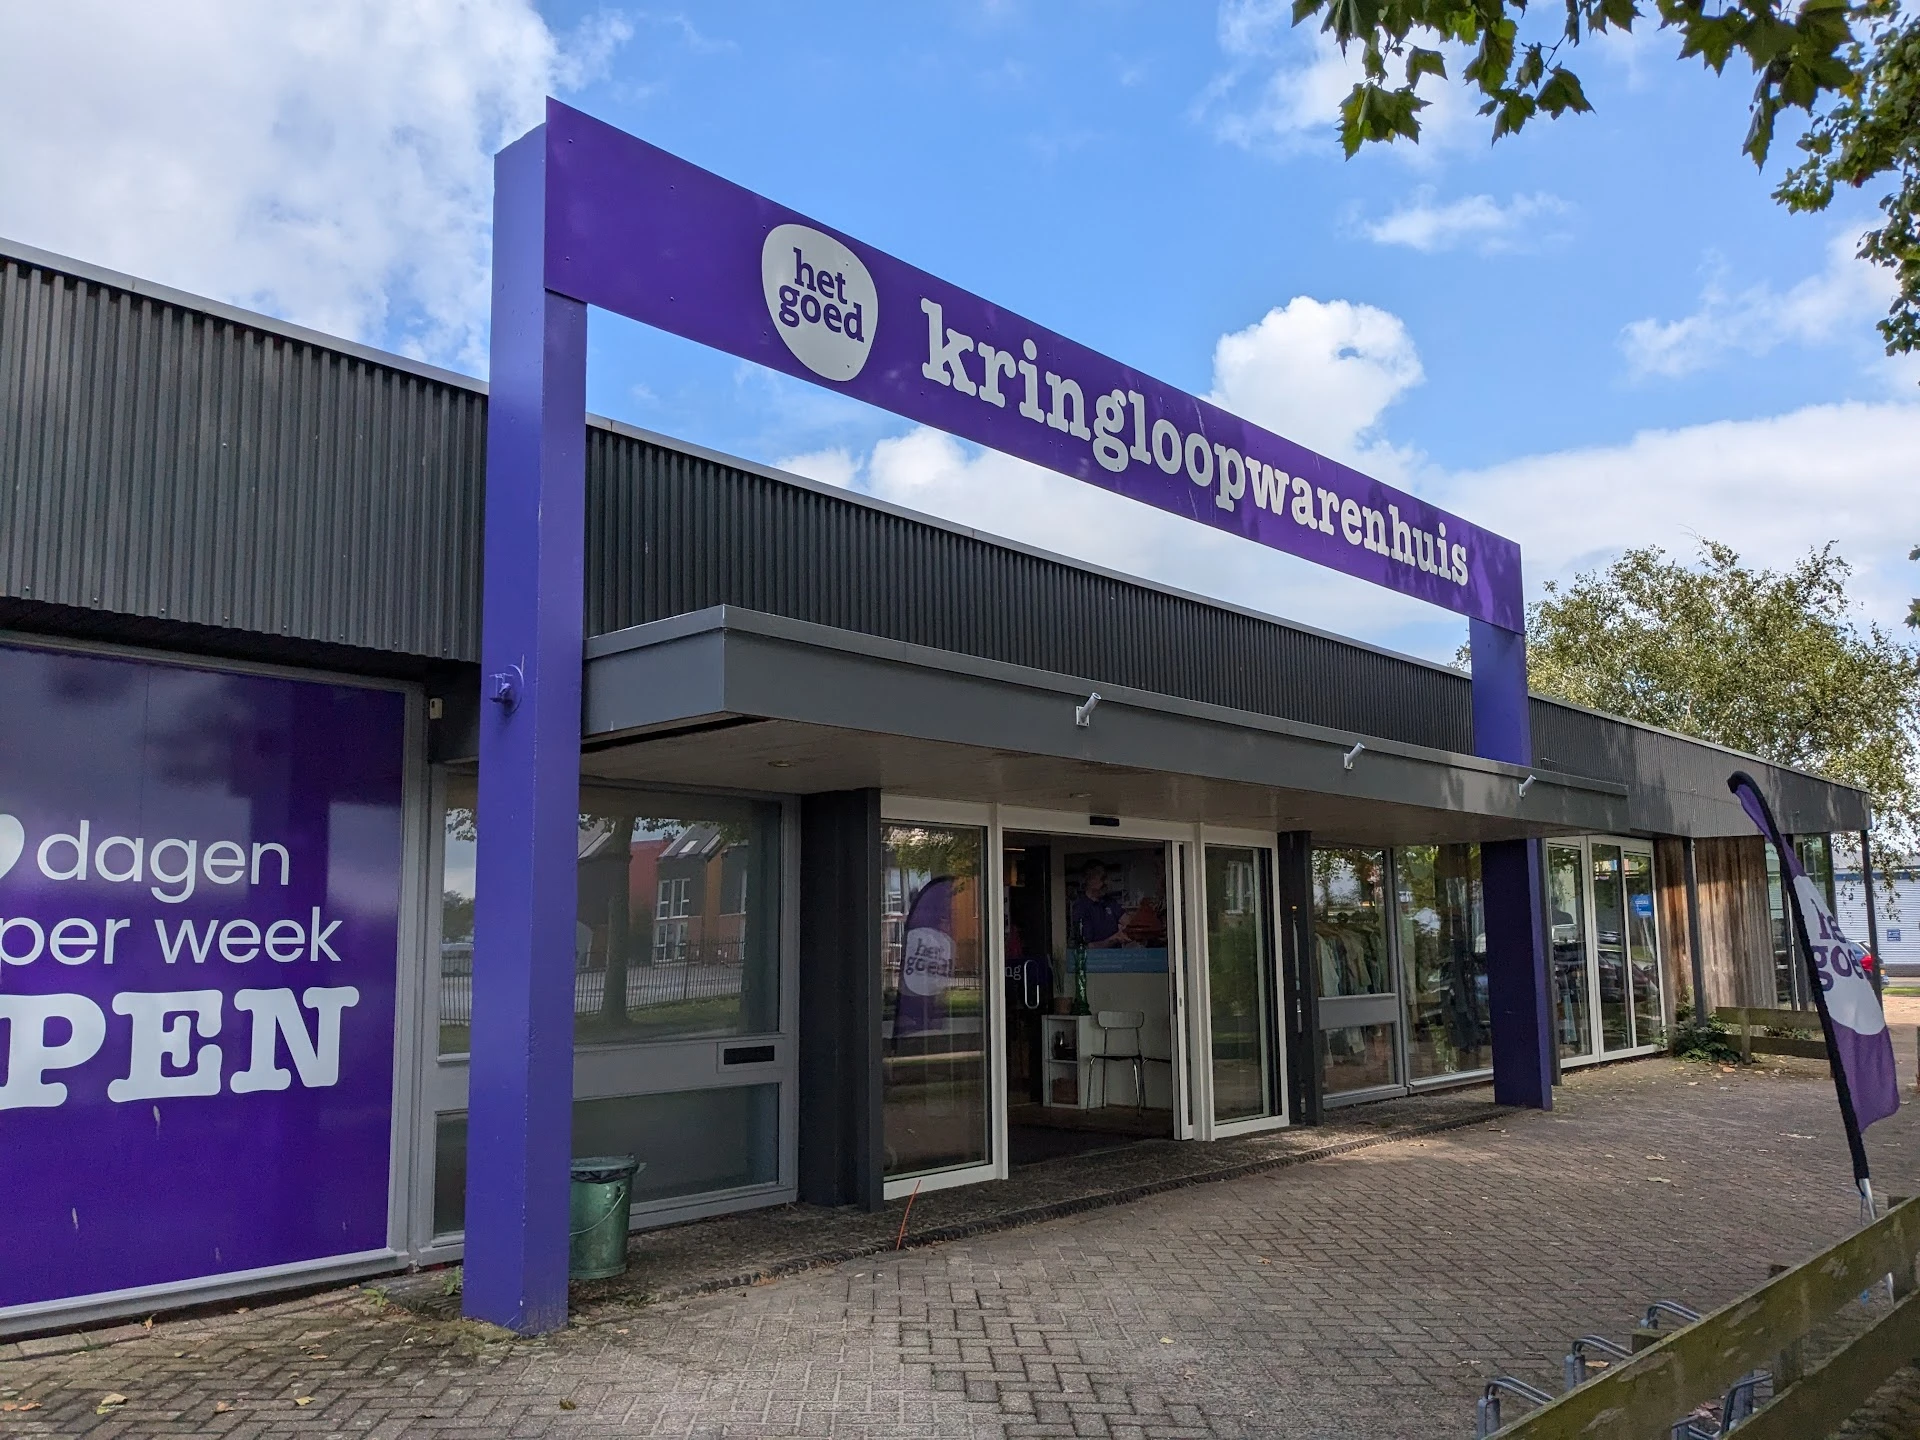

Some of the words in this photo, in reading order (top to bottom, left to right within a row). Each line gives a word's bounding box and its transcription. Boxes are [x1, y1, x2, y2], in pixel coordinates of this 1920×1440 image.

[793, 247, 848, 305] het
[778, 285, 865, 343] goed
[920, 297, 1469, 587] kringloopwarenhuis
[36, 819, 290, 904] dagen
[0, 917, 131, 967] per
[155, 906, 343, 964] week
